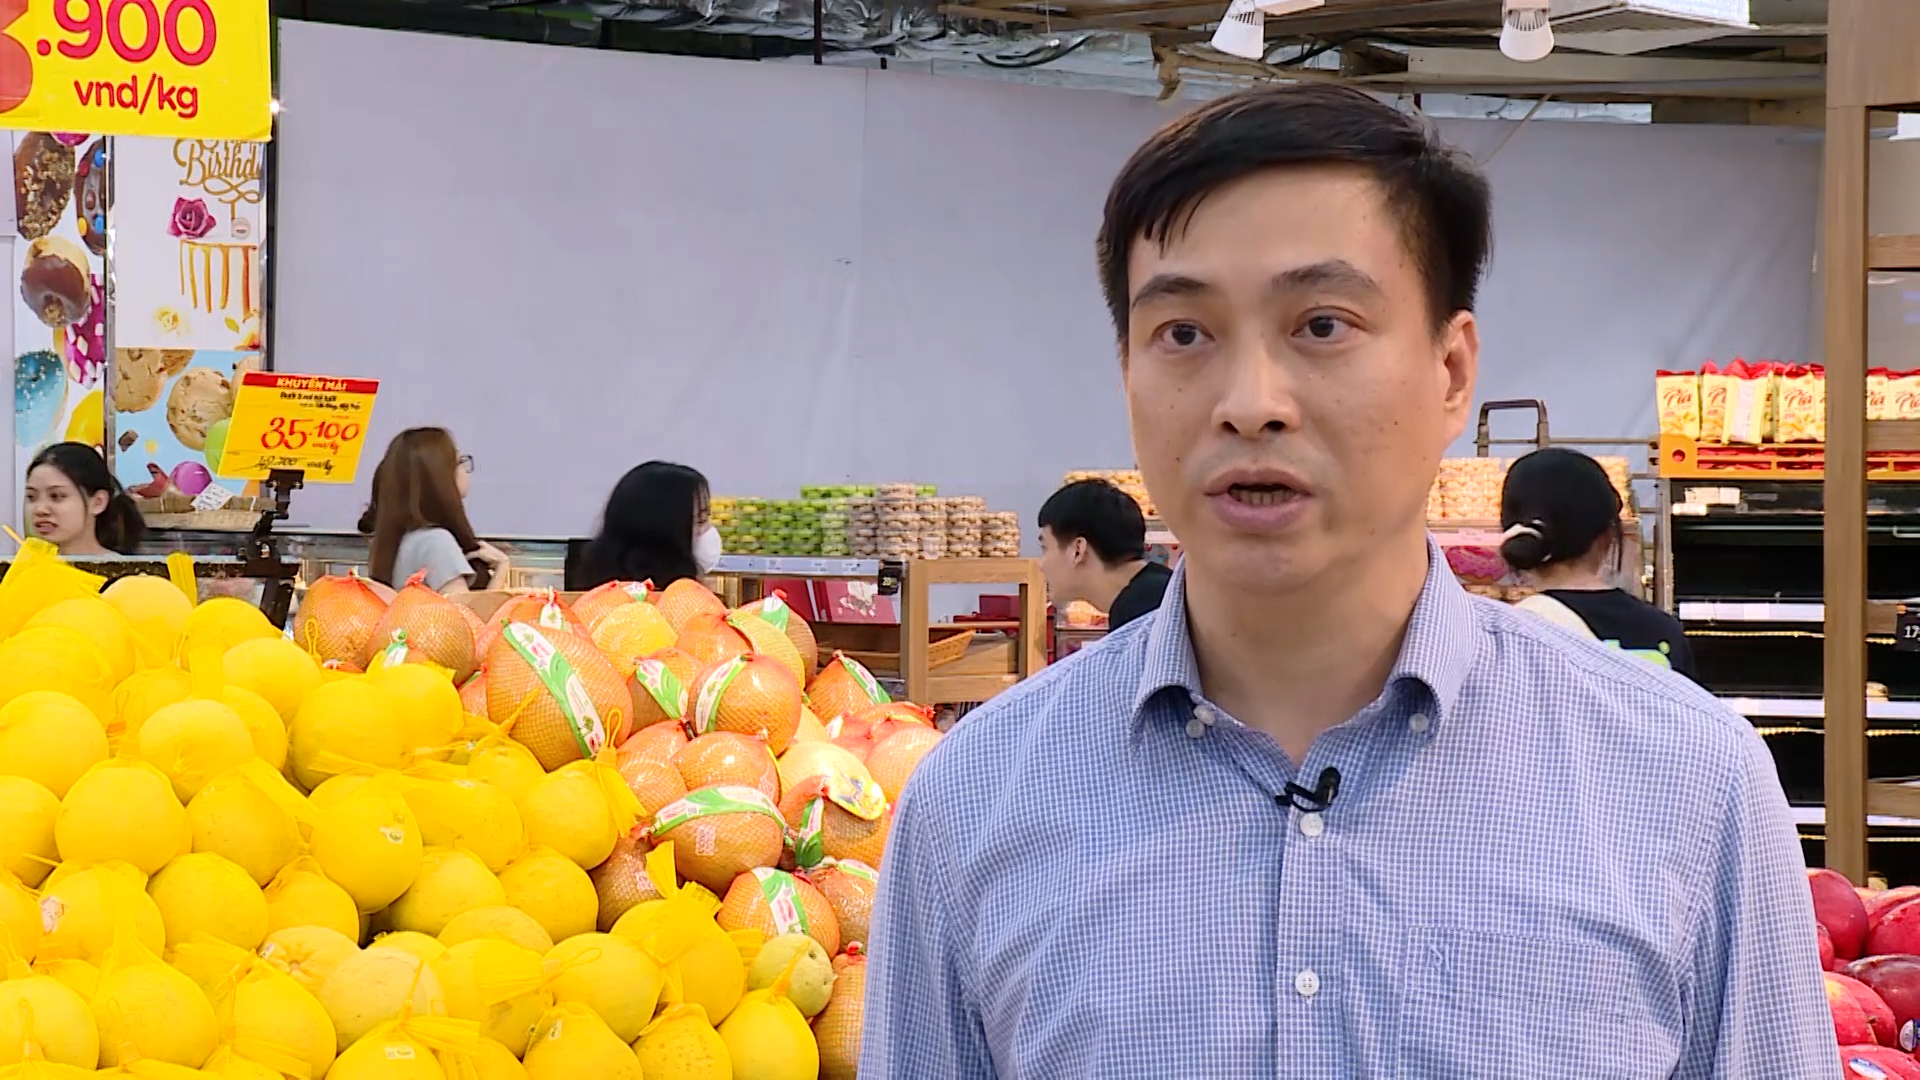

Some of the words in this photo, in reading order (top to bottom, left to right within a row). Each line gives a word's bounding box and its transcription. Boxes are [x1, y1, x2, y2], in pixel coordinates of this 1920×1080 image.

[74, 73, 198, 119] vnd/kg
[173, 138, 260, 186] Birthd
[261, 416, 360, 450] 35.100
